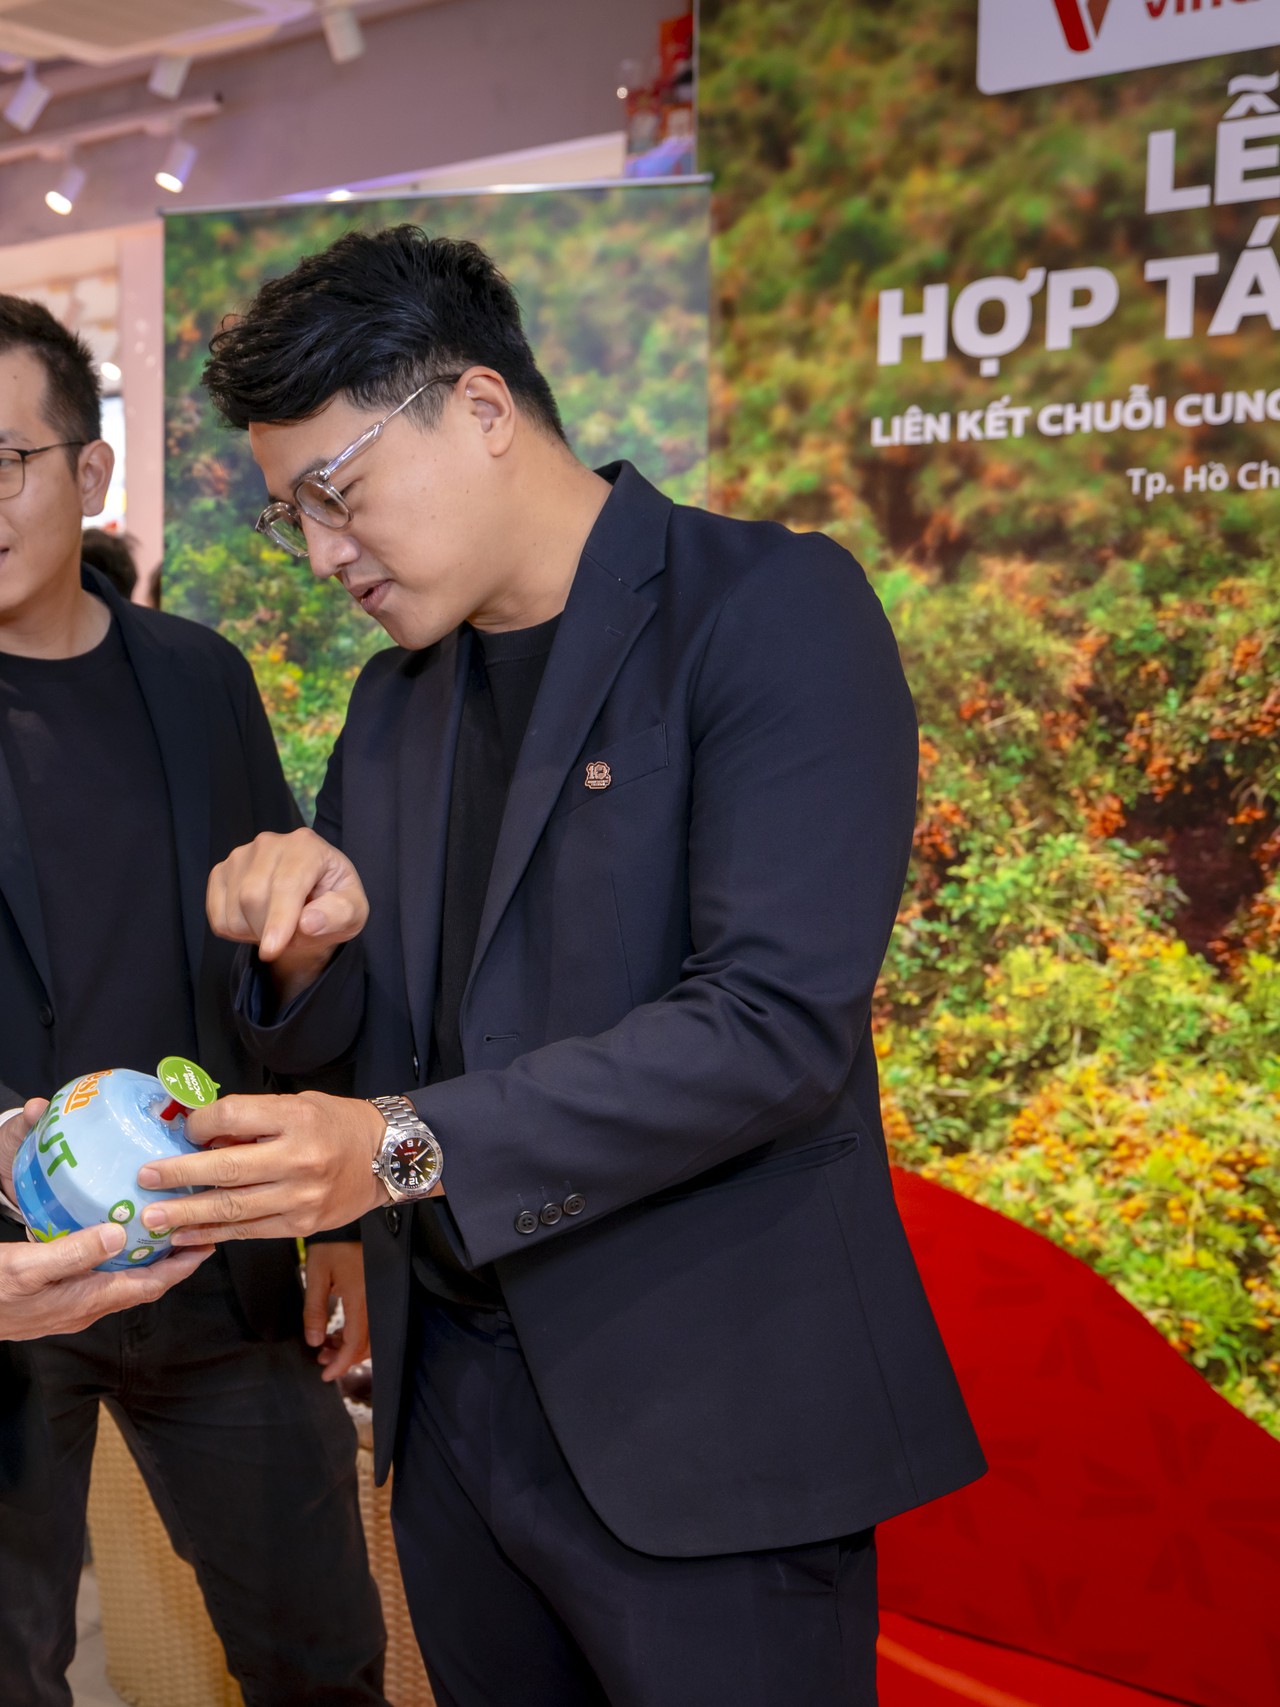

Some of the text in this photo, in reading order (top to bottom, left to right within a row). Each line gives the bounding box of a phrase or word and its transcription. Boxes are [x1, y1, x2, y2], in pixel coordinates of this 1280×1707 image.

[1145, 70, 1280, 214] LỄ
[877, 266, 1120, 378] HỢP
[870, 404, 951, 447] LIÊN
[956, 394, 1033, 442] KẾT
[1037, 383, 1168, 438] CHUỖI
[1126, 466, 1175, 502] Tp.
[1183, 460, 1230, 493] Hồ
